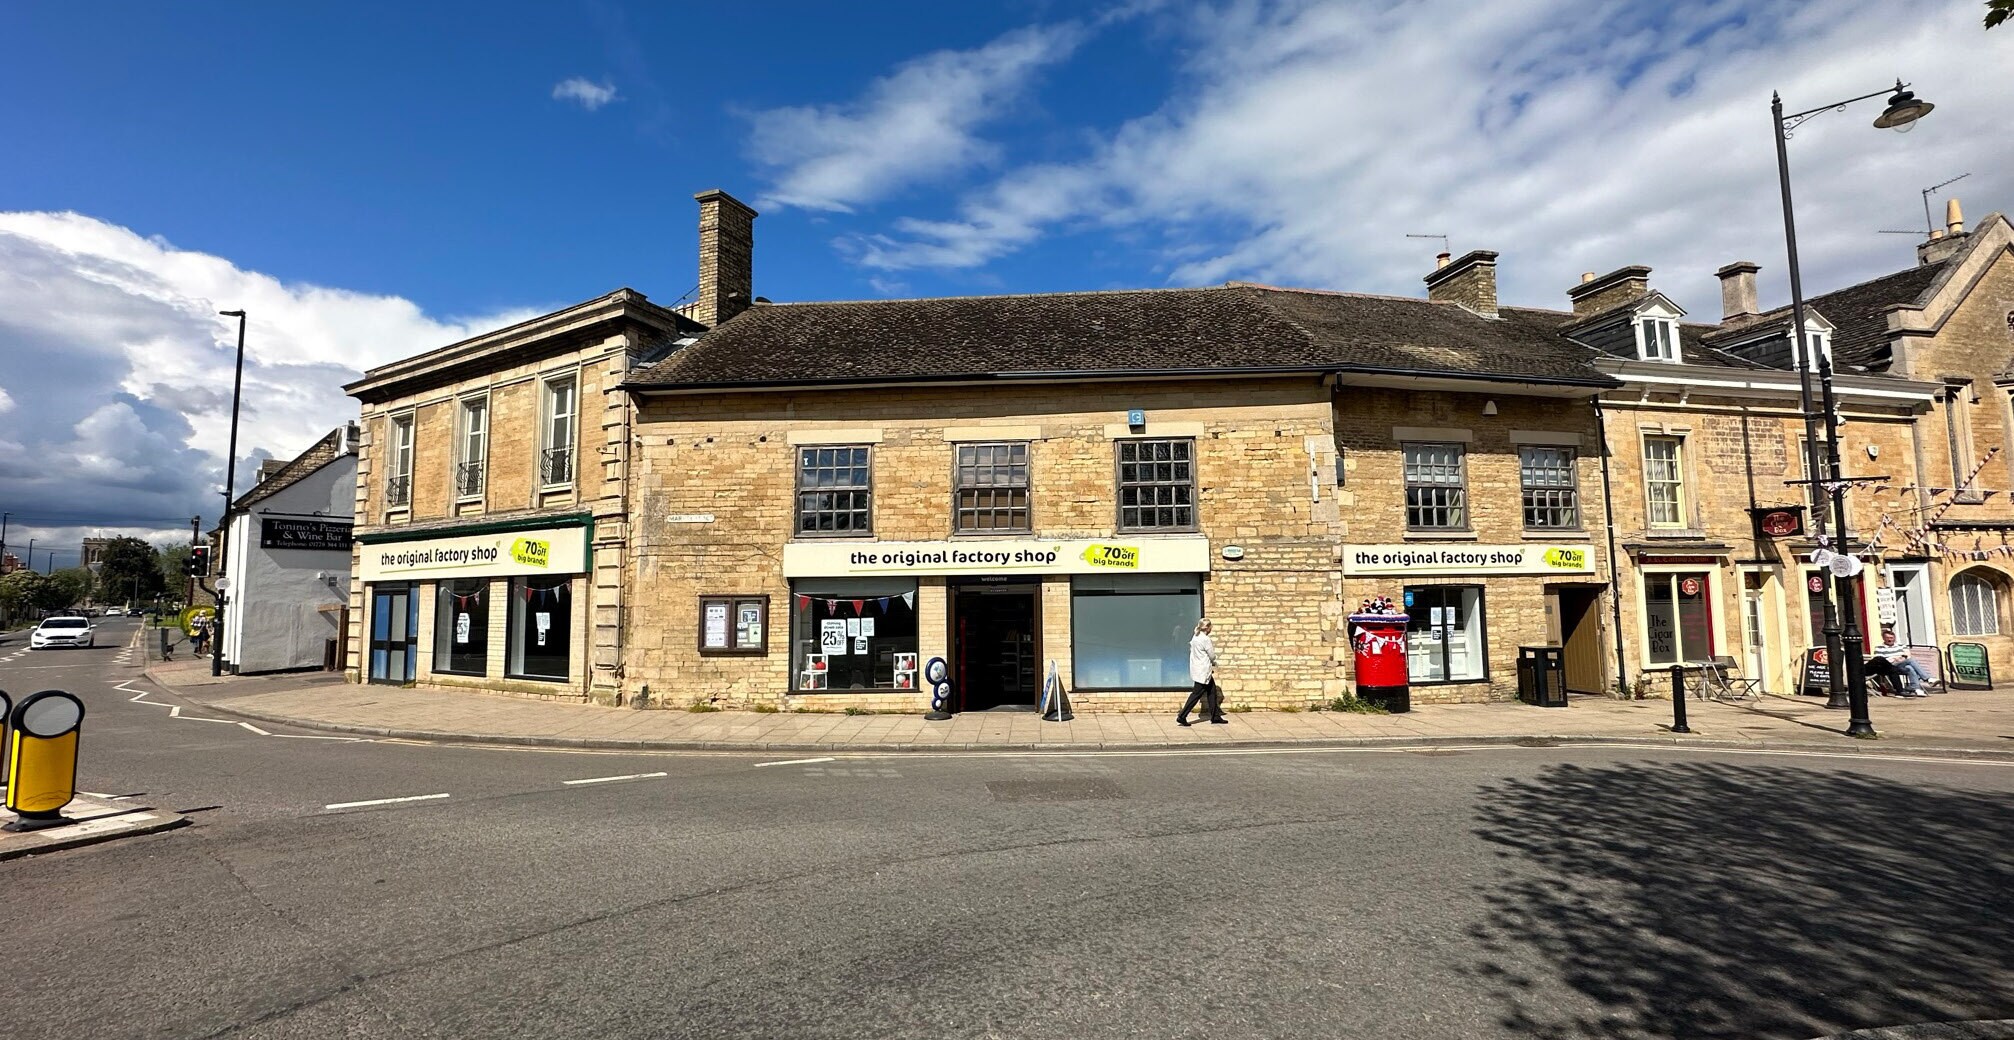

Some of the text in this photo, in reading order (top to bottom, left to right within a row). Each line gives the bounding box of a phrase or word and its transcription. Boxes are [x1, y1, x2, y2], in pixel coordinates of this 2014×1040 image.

[272, 521, 352, 532] Tonino's Pizzeria
[283, 531, 342, 540] & Wine Bar
[381, 546, 498, 567] the original factory shop
[537, 548, 547, 557] off
[850, 549, 1056, 566] the original factory shop
[1122, 552, 1135, 560] off
[517, 554, 545, 566] big brands
[1093, 558, 1134, 567] big brands
[1355, 551, 1522, 567] the original factory shop
[1650, 615, 1667, 627] The
[823, 631, 836, 645] 25
[1648, 627, 1672, 642] Cigar
[1652, 640, 1670, 653] Box
[1958, 667, 1987, 675] OPEN
